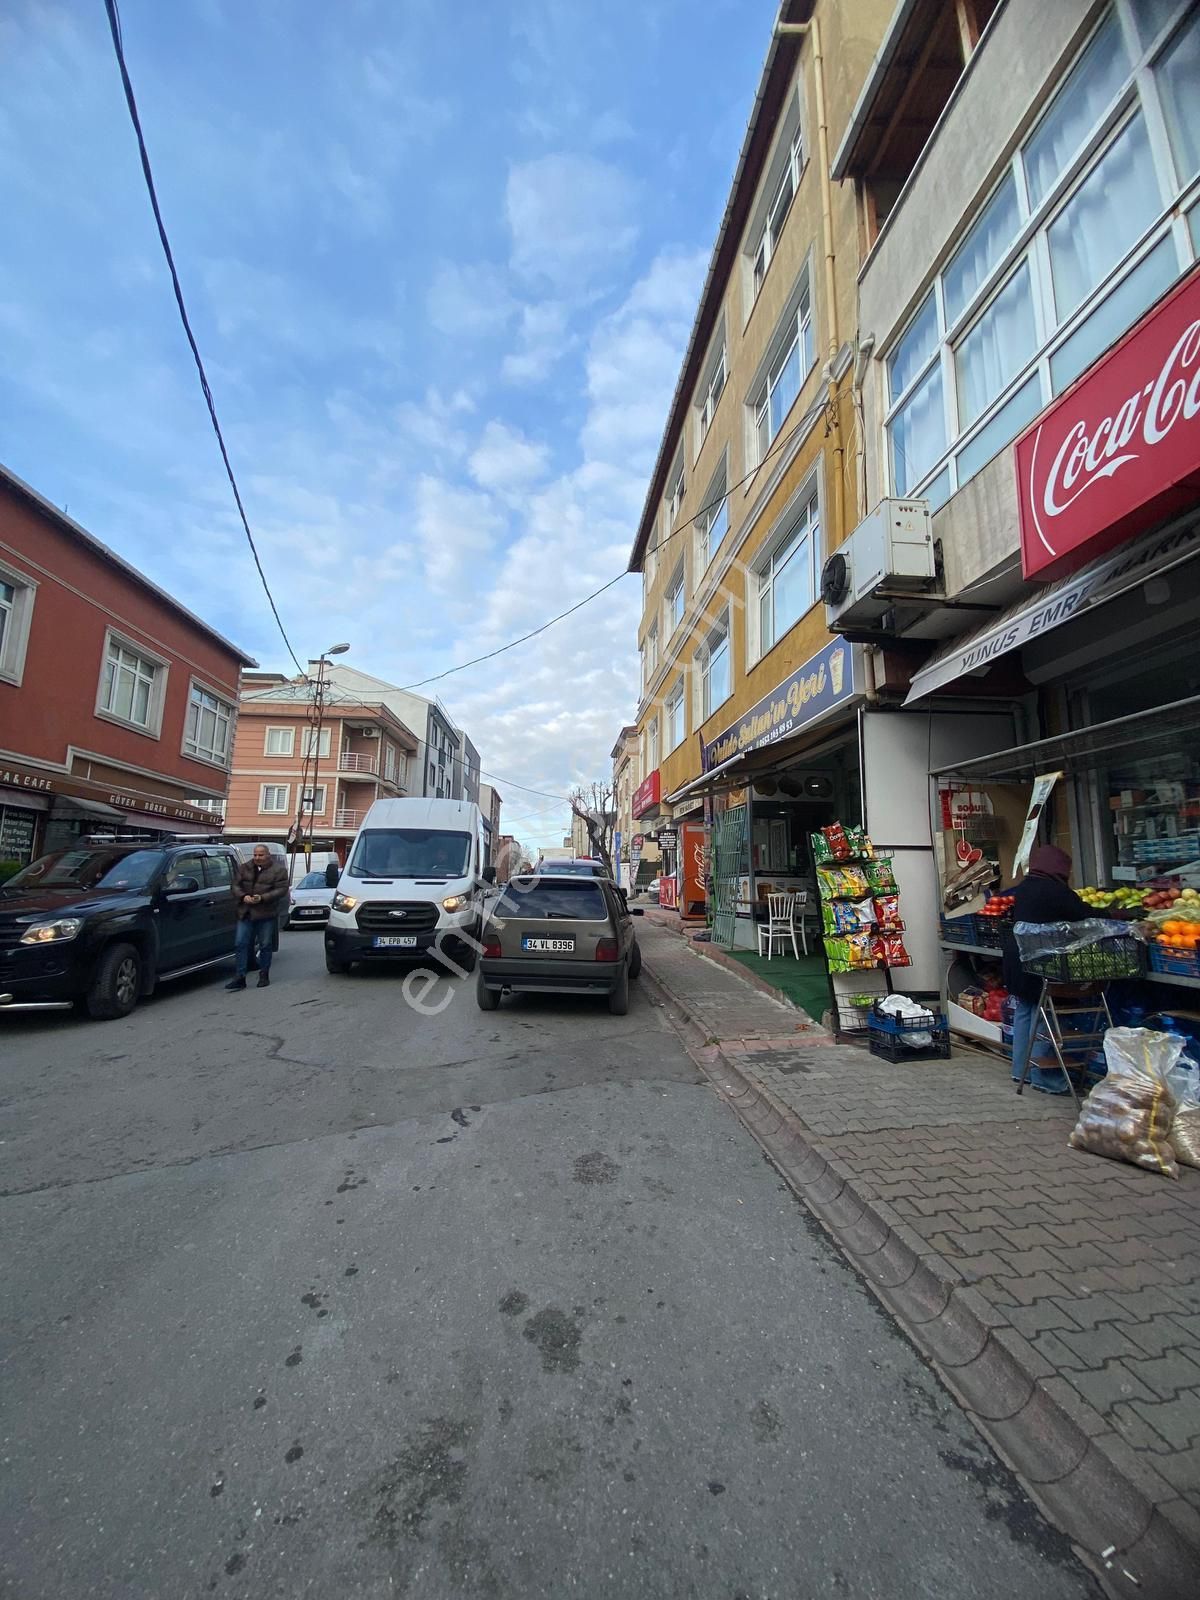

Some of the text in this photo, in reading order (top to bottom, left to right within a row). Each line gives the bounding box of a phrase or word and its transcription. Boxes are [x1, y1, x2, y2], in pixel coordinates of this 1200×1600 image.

[960, 627, 1020, 671] YUNUS
[24, 776, 52, 790] CAFE
[527, 940, 573, 950] 34 VL 8396
